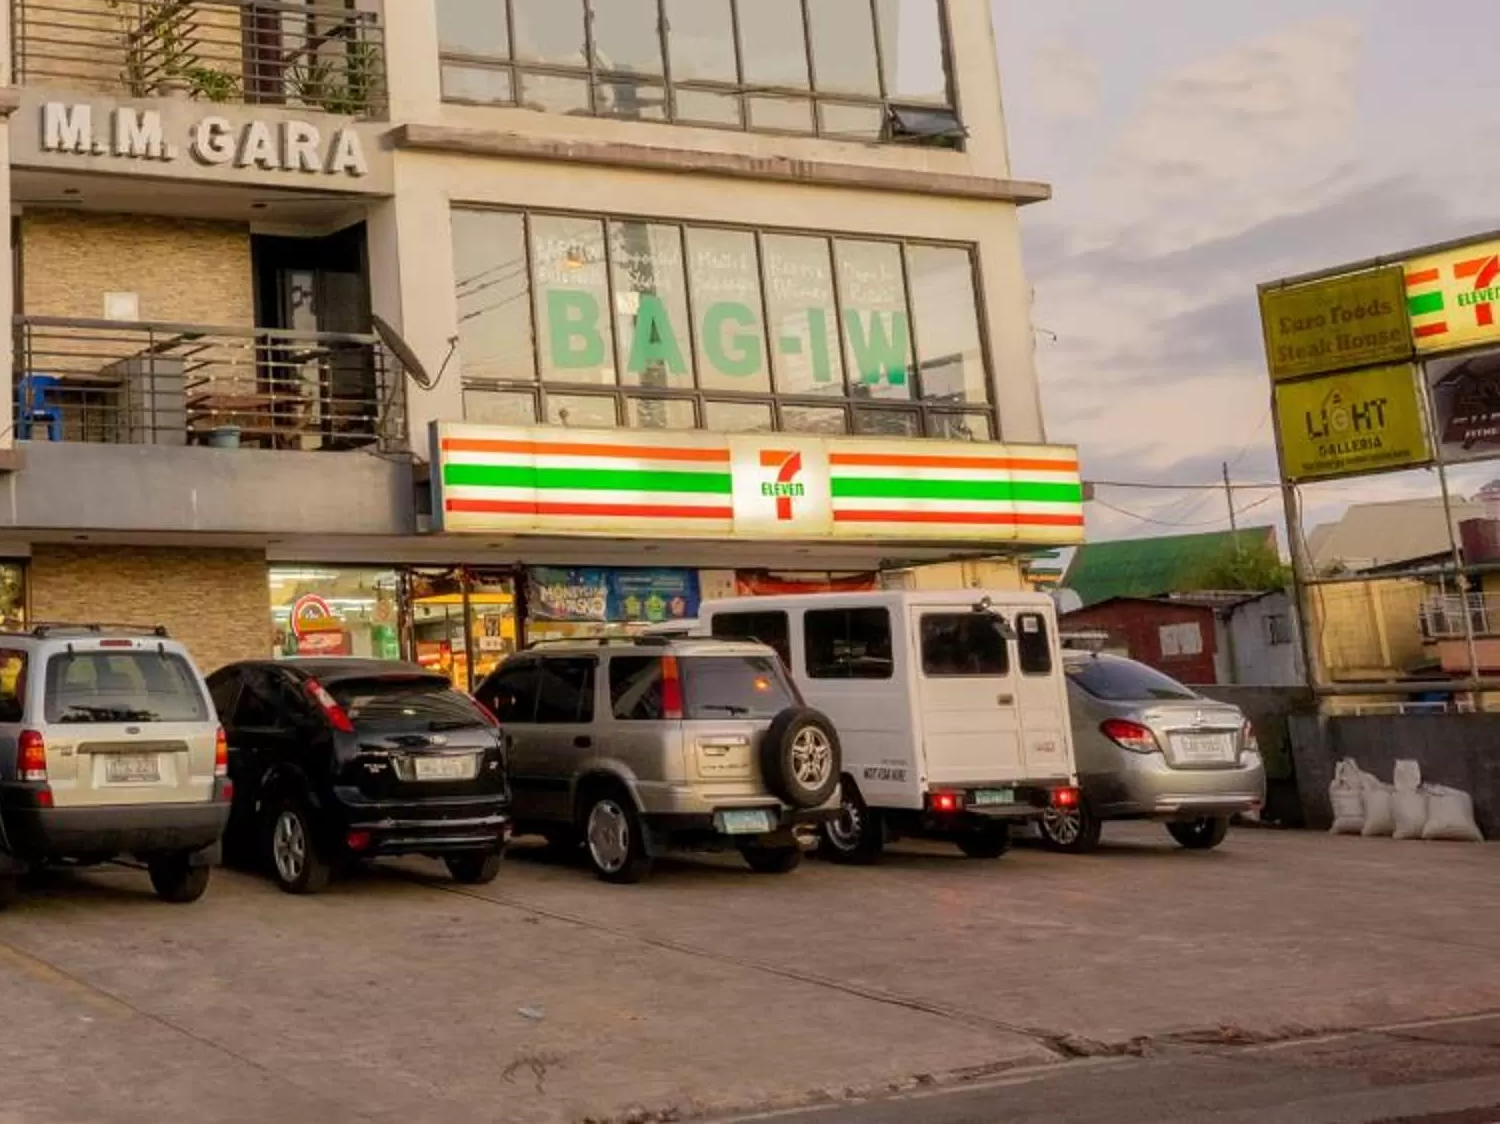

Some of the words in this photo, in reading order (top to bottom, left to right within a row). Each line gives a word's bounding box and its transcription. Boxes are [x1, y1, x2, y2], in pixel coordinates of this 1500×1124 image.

[41, 102, 178, 160] M.M.
[191, 115, 369, 177] GARA
[545, 288, 909, 386] BAG-IW
[1279, 313, 1326, 336] Euro
[1330, 299, 1393, 325] Foods
[1277, 337, 1334, 364] Steak
[1335, 326, 1403, 351] House
[1304, 396, 1388, 442] LIGHT
[1318, 437, 1383, 457] GALLERIA
[759, 449, 802, 521] 7
